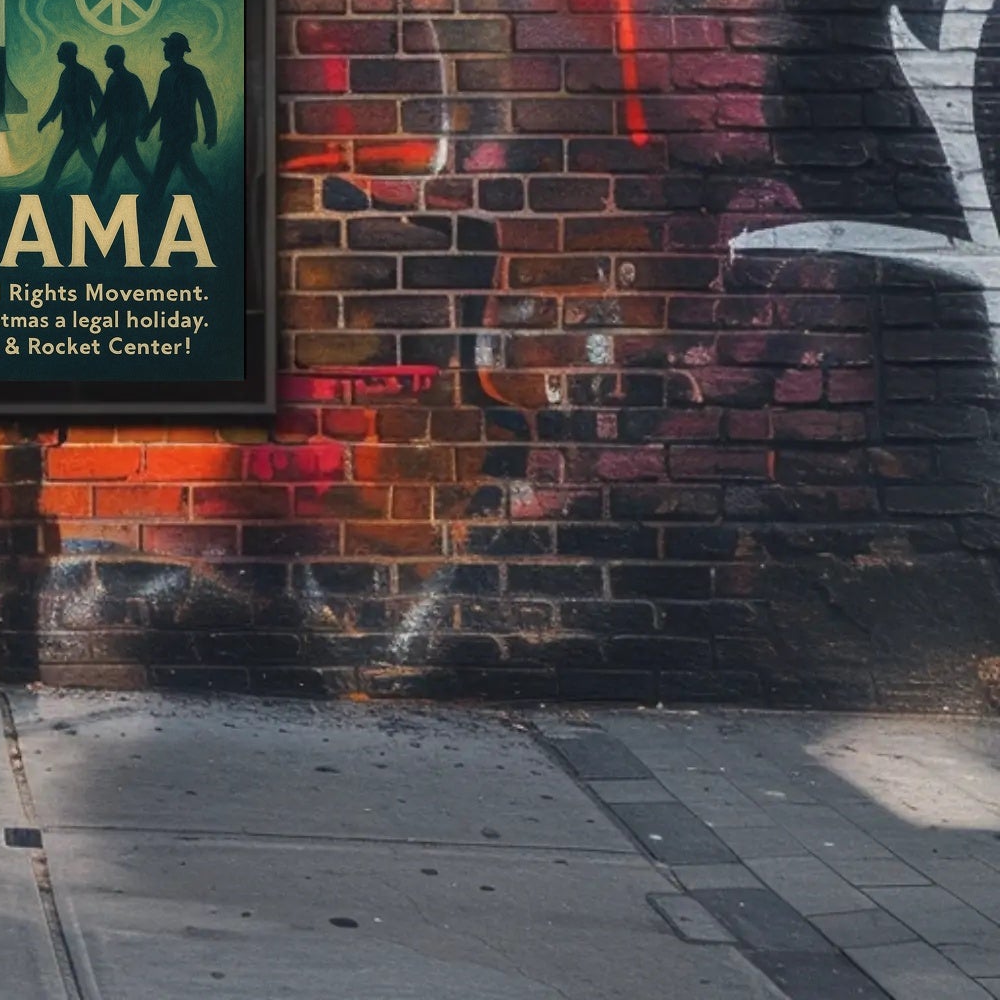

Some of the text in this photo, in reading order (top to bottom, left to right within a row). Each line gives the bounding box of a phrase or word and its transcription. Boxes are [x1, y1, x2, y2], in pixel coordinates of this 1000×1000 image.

[9, 283, 78, 309] Rights
[86, 283, 209, 302] Movement.
[54, 316, 66, 328] a
[73, 310, 119, 335] legal
[126, 310, 209, 334] holiday.
[4, 336, 20, 355] &
[28, 336, 101, 355] Rocket
[108, 336, 191, 355] Center!
